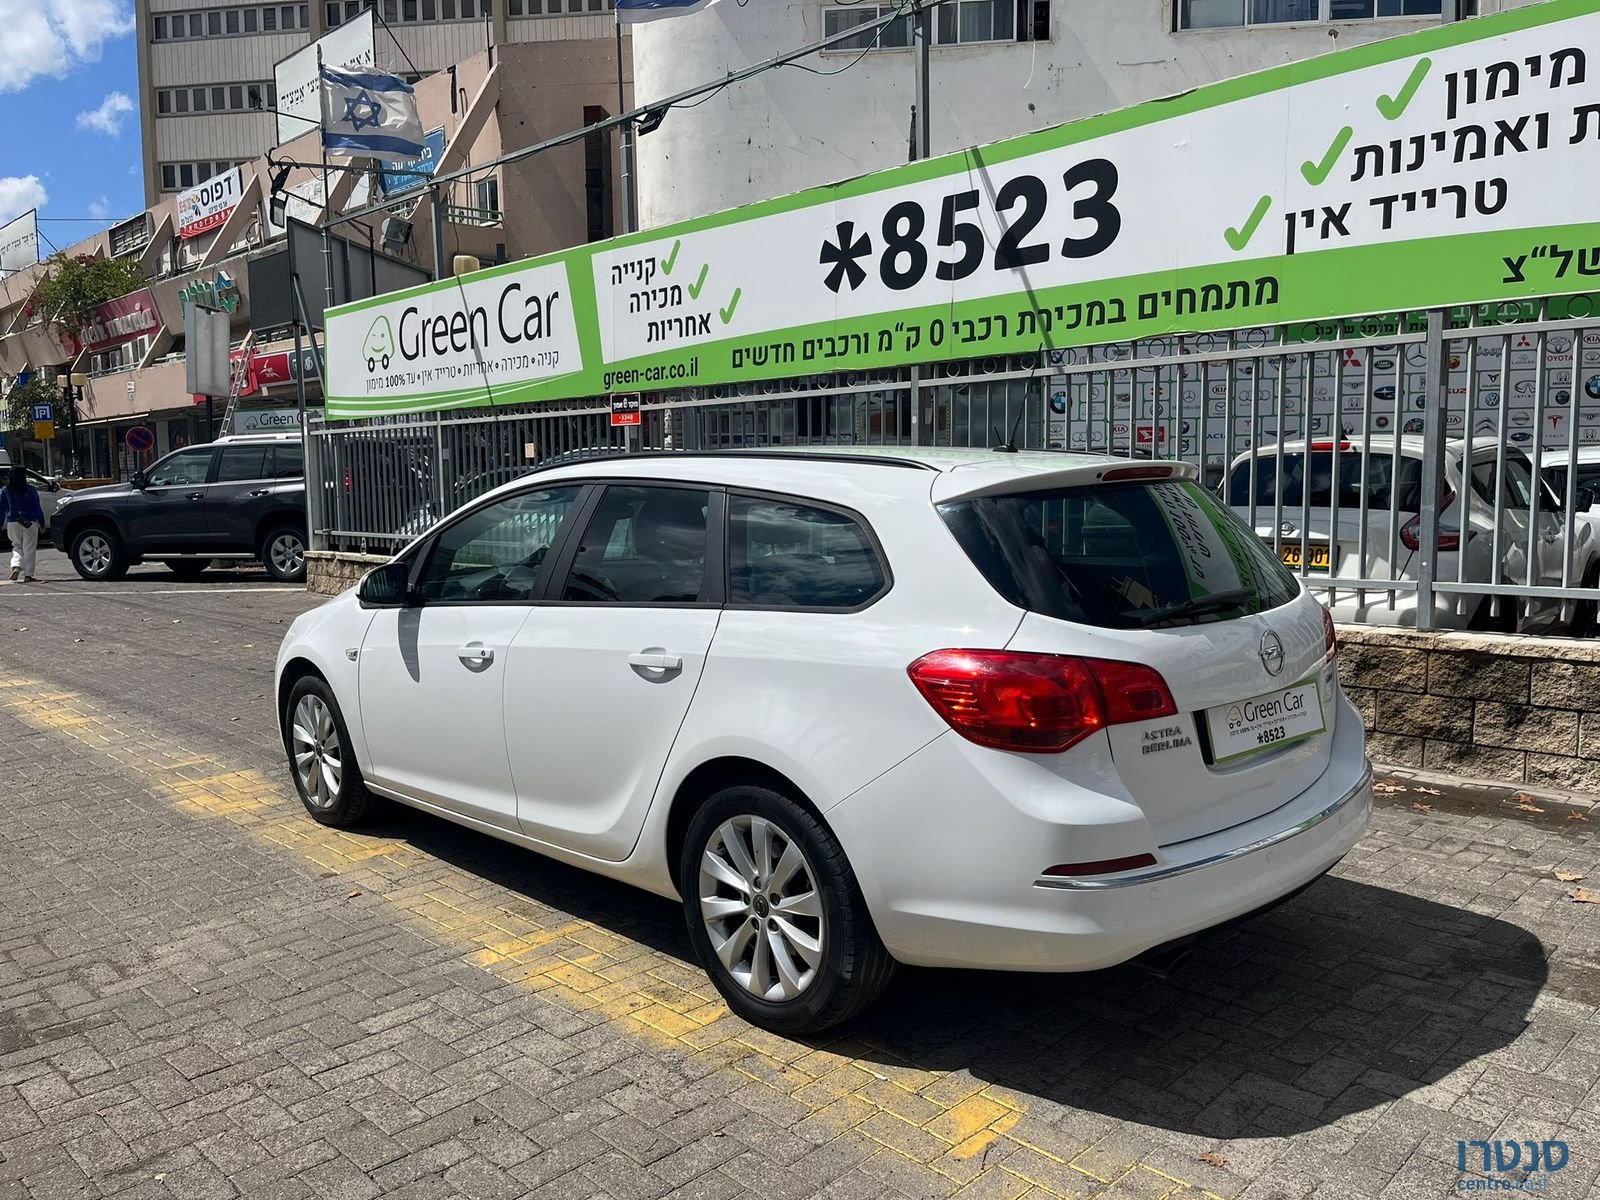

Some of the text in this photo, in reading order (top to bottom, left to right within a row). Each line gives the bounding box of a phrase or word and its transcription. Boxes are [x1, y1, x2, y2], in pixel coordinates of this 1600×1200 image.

[1444, 47, 1586, 121] מימון
[1350, 111, 1549, 183] ואמינות
[200, 176, 232, 207] דפוס
[1284, 176, 1508, 256] טרייד אין
[611, 256, 656, 286] קנייה
[629, 284, 682, 314] מכירה
[1137, 274, 1279, 319] מתמחים
[398, 282, 559, 361] Green Car
[646, 312, 712, 343] אחריות
[951, 314, 1008, 342] רכבי
[1015, 297, 1127, 337] במכירת
[802, 332, 870, 361] ורכבים
[928, 318, 945, 347] 0
[732, 342, 795, 369] חדשים
[366, 350, 559, 394] קניה מכירה אחריות טרייד אין עד 100% מימון
[603, 357, 699, 390] green-car.co.il
[260, 413, 294, 426] Green
[1244, 692, 1304, 722] Green Car
[1141, 726, 1183, 742] ASTRA
[1141, 736, 1193, 755] BERLINA
